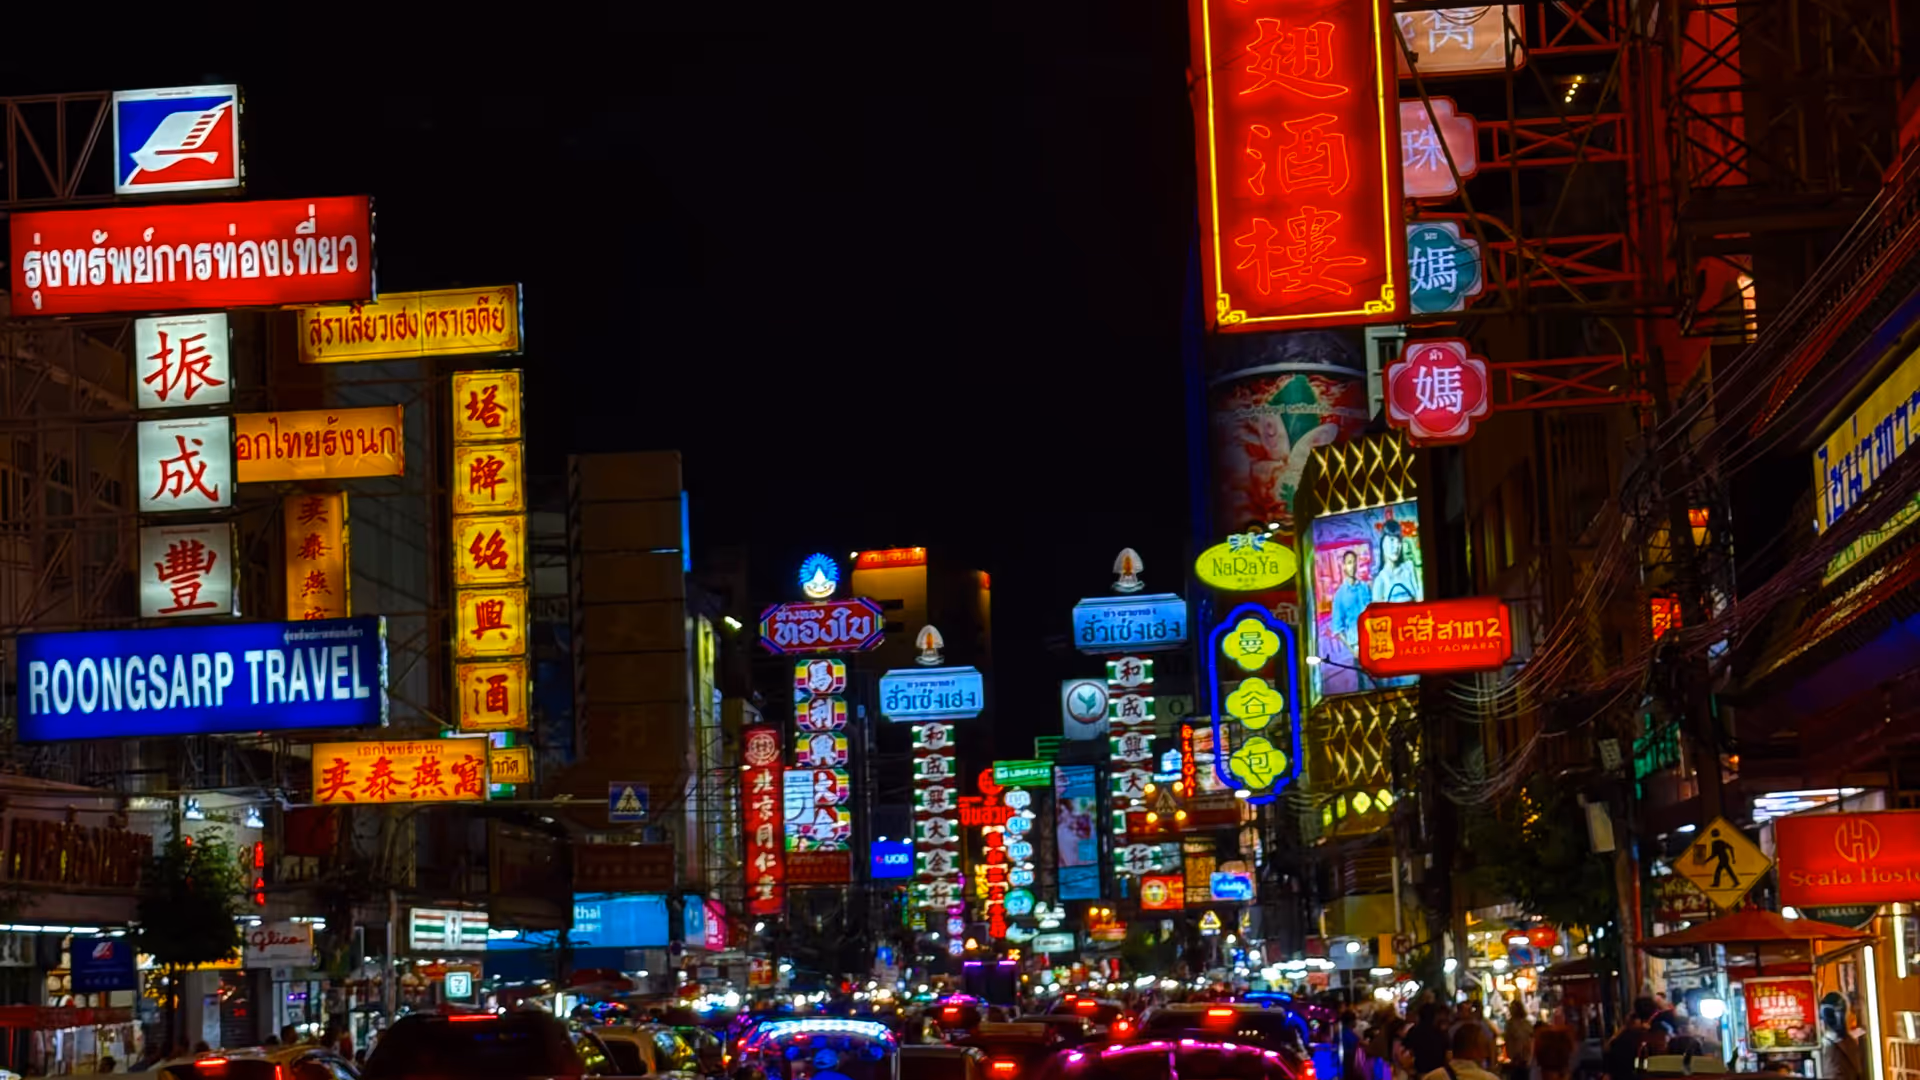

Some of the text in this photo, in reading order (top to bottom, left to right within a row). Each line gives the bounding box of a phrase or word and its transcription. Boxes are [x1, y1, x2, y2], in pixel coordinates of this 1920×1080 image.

[1235, 0, 1367, 295] 翅酒樓
[22, 204, 358, 310] รุ่งทรัพย์การท่องเที่ยว
[1408, 246, 1458, 295] 媽
[1413, 365, 1463, 415] 媽
[1212, 555, 1279, 577] NaRaYa
[774, 607, 871, 646] ทองใบ
[1437, 641, 1501, 653] YAOWARAT
[29, 645, 371, 716] ROONGSARP TRAVEL
[1238, 631, 1273, 786] 曼谷包
[1120, 661, 1147, 871] 和成興大行
[752, 769, 777, 900] 北京同仁堂
[884, 853, 909, 865] UOB
[1789, 868, 1852, 887] Scala
[252, 930, 305, 952] Glico
